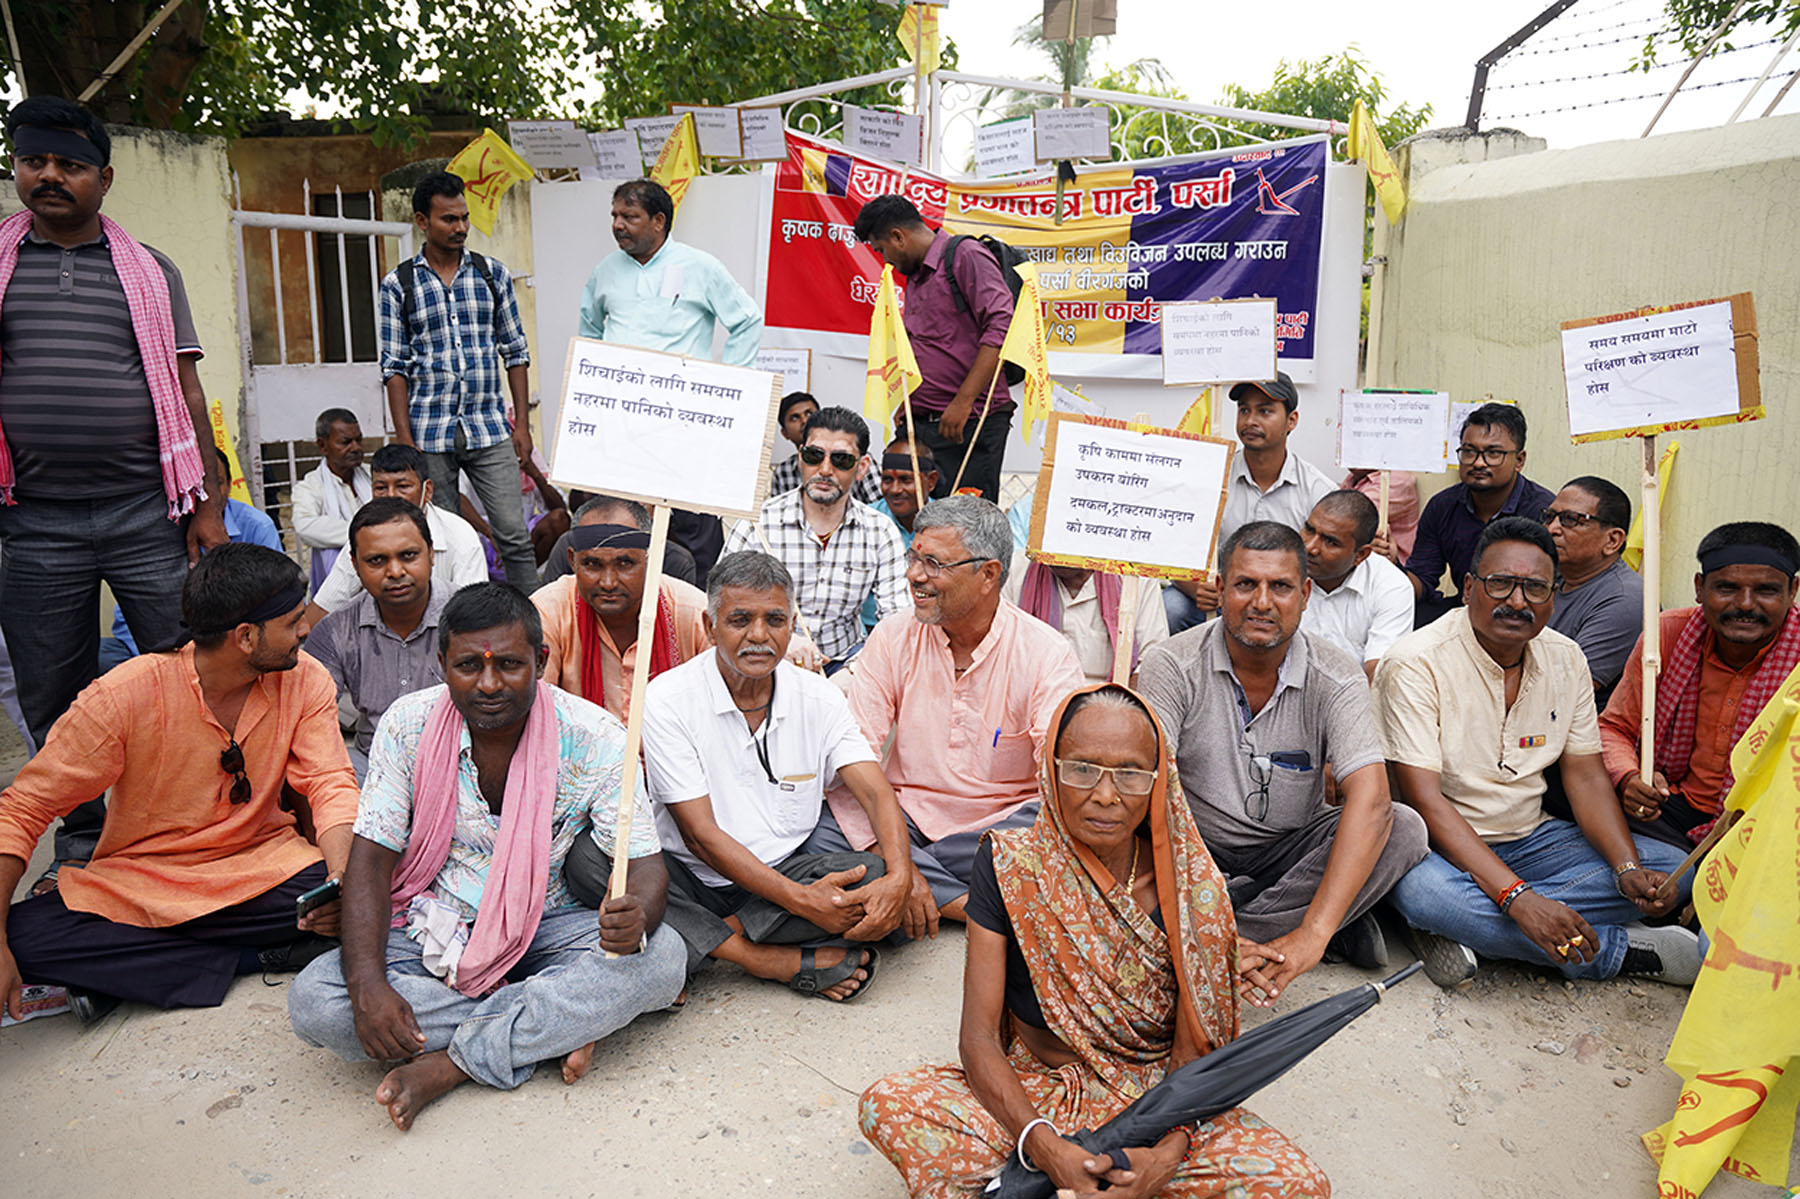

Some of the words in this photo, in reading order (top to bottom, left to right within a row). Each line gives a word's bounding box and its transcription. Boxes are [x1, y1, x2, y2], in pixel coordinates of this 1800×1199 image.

[1170, 167, 1236, 209] पर्सा
[781, 218, 823, 243] कृषक
[1063, 246, 1095, 264] तथा
[1174, 242, 1229, 262] उपलब्ध
[1234, 240, 1289, 261] गराउन
[1039, 270, 1071, 290] पर्सा
[1076, 267, 1150, 291] वीरगंजको
[1053, 300, 1098, 321] सभा
[1589, 336, 1618, 350] समय
[1621, 328, 1665, 344] समयमा
[1669, 320, 1698, 336] माटो
[1584, 353, 1626, 373] परिक्षण
[1628, 352, 1647, 365] को
[1650, 345, 1700, 363] व्यवस्था
[578, 358, 645, 385] शिचाईको
[649, 374, 687, 393] लागि
[690, 380, 743, 402] समयमा
[1586, 380, 1610, 396] होस
[573, 391, 618, 410] नहरमा
[621, 397, 674, 420] पानिको
[677, 408, 735, 430] व्यवस्था
[568, 416, 597, 437] होस
[1078, 441, 1104, 462] कृषि
[1105, 447, 1143, 464] काममा
[1066, 517, 1083, 534] को
[1084, 522, 1128, 539] व्यवस्था
[1130, 525, 1152, 542] होस
